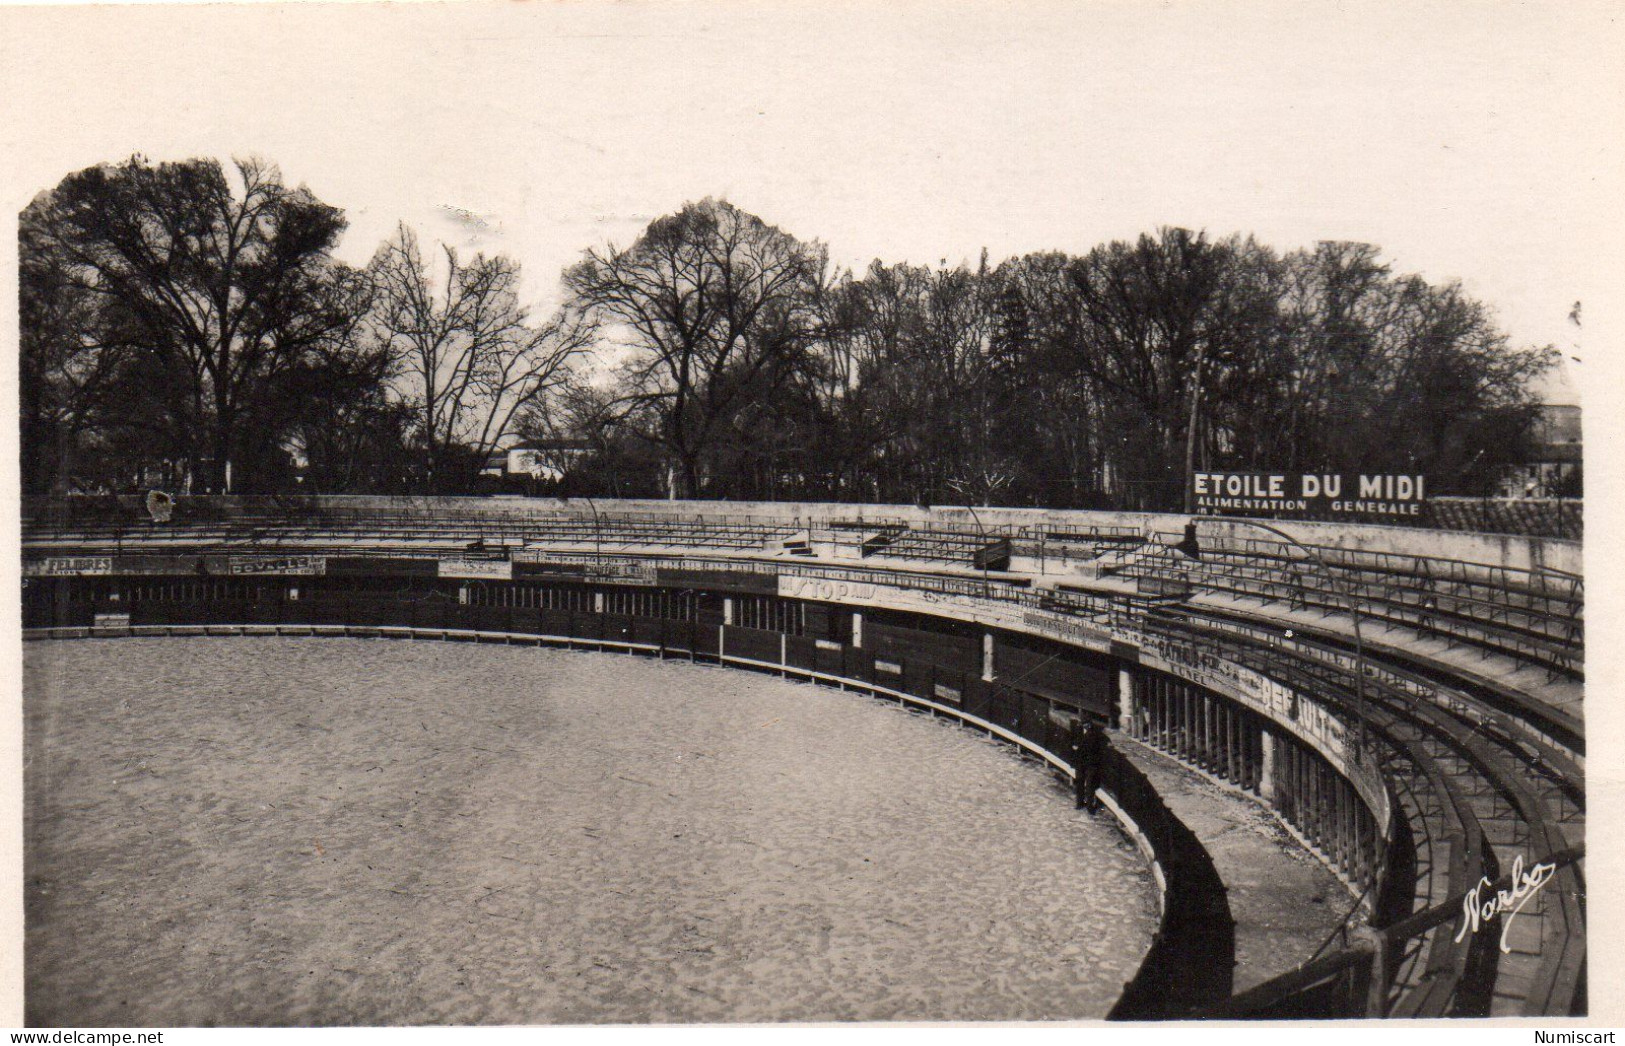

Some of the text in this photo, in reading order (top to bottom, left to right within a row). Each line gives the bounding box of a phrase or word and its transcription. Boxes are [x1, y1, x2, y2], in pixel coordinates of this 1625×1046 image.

[1195, 473, 1423, 500] ETOILE DU MIDI
[1198, 496, 1419, 515] ALIMENTATION GENERALE
